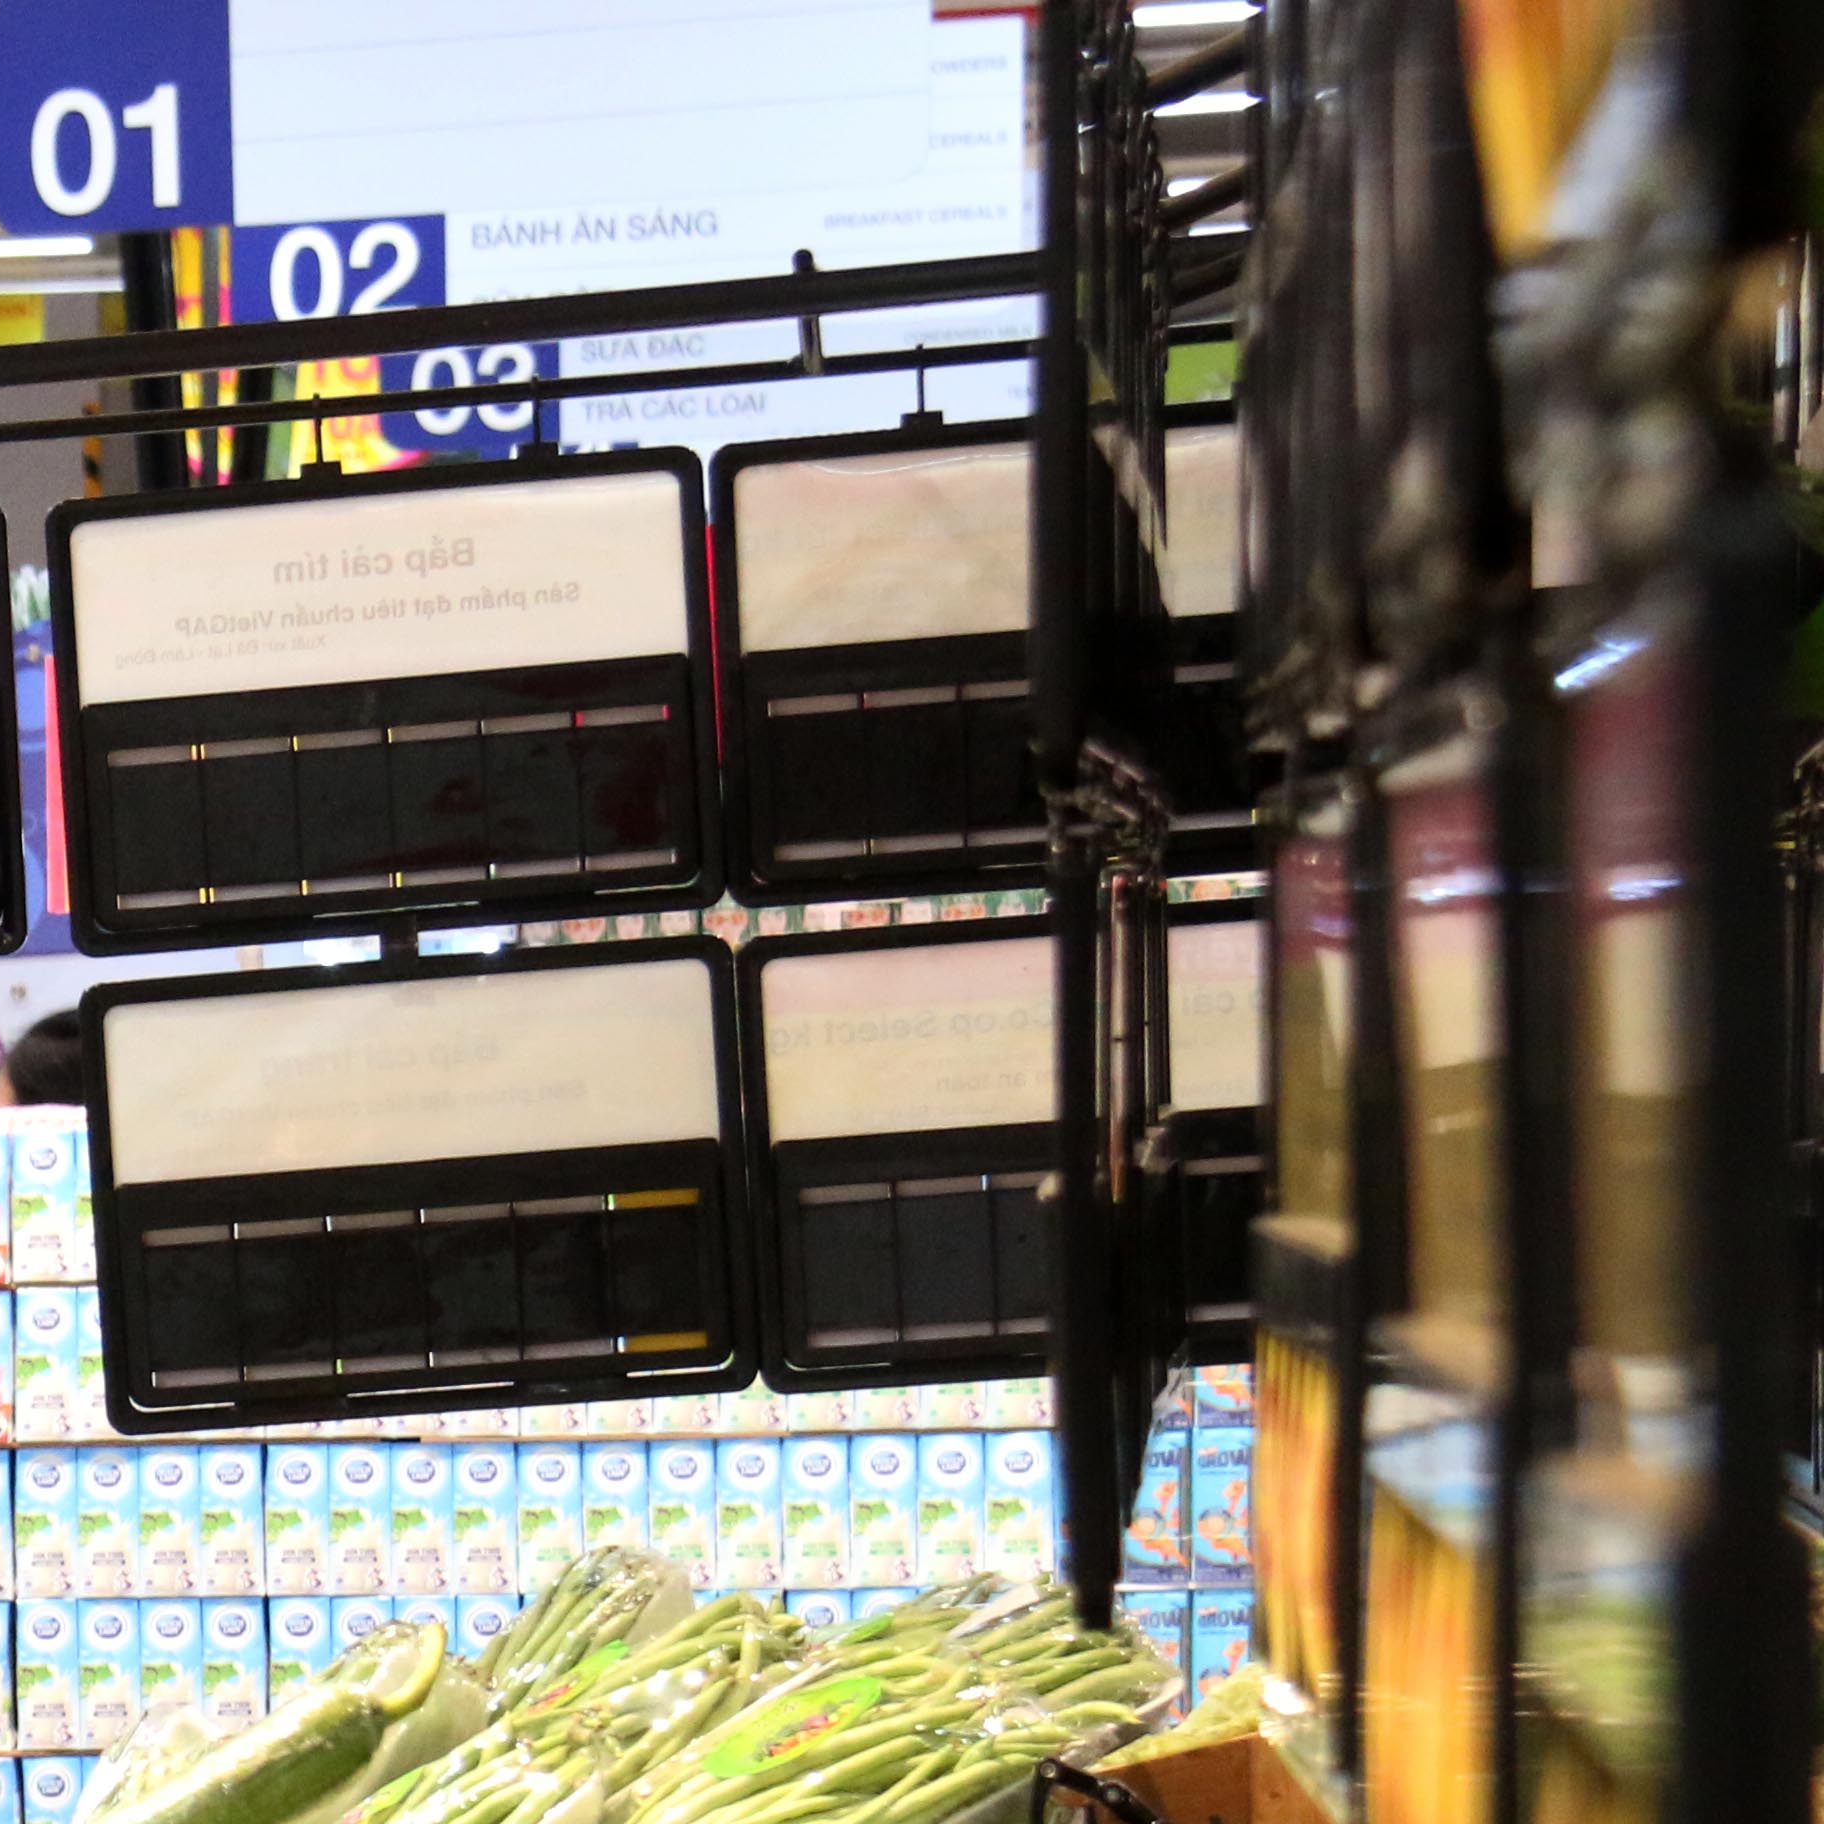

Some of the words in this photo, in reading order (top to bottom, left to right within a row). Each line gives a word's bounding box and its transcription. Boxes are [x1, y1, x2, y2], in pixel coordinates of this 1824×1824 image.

[31, 84, 181, 216] 01
[269, 224, 420, 322] 02
[470, 215, 563, 250] BÁNH
[571, 208, 620, 245] ĂN
[627, 206, 719, 243] SÁNG
[410, 343, 536, 435] 03
[643, 392, 699, 420] CÁC
